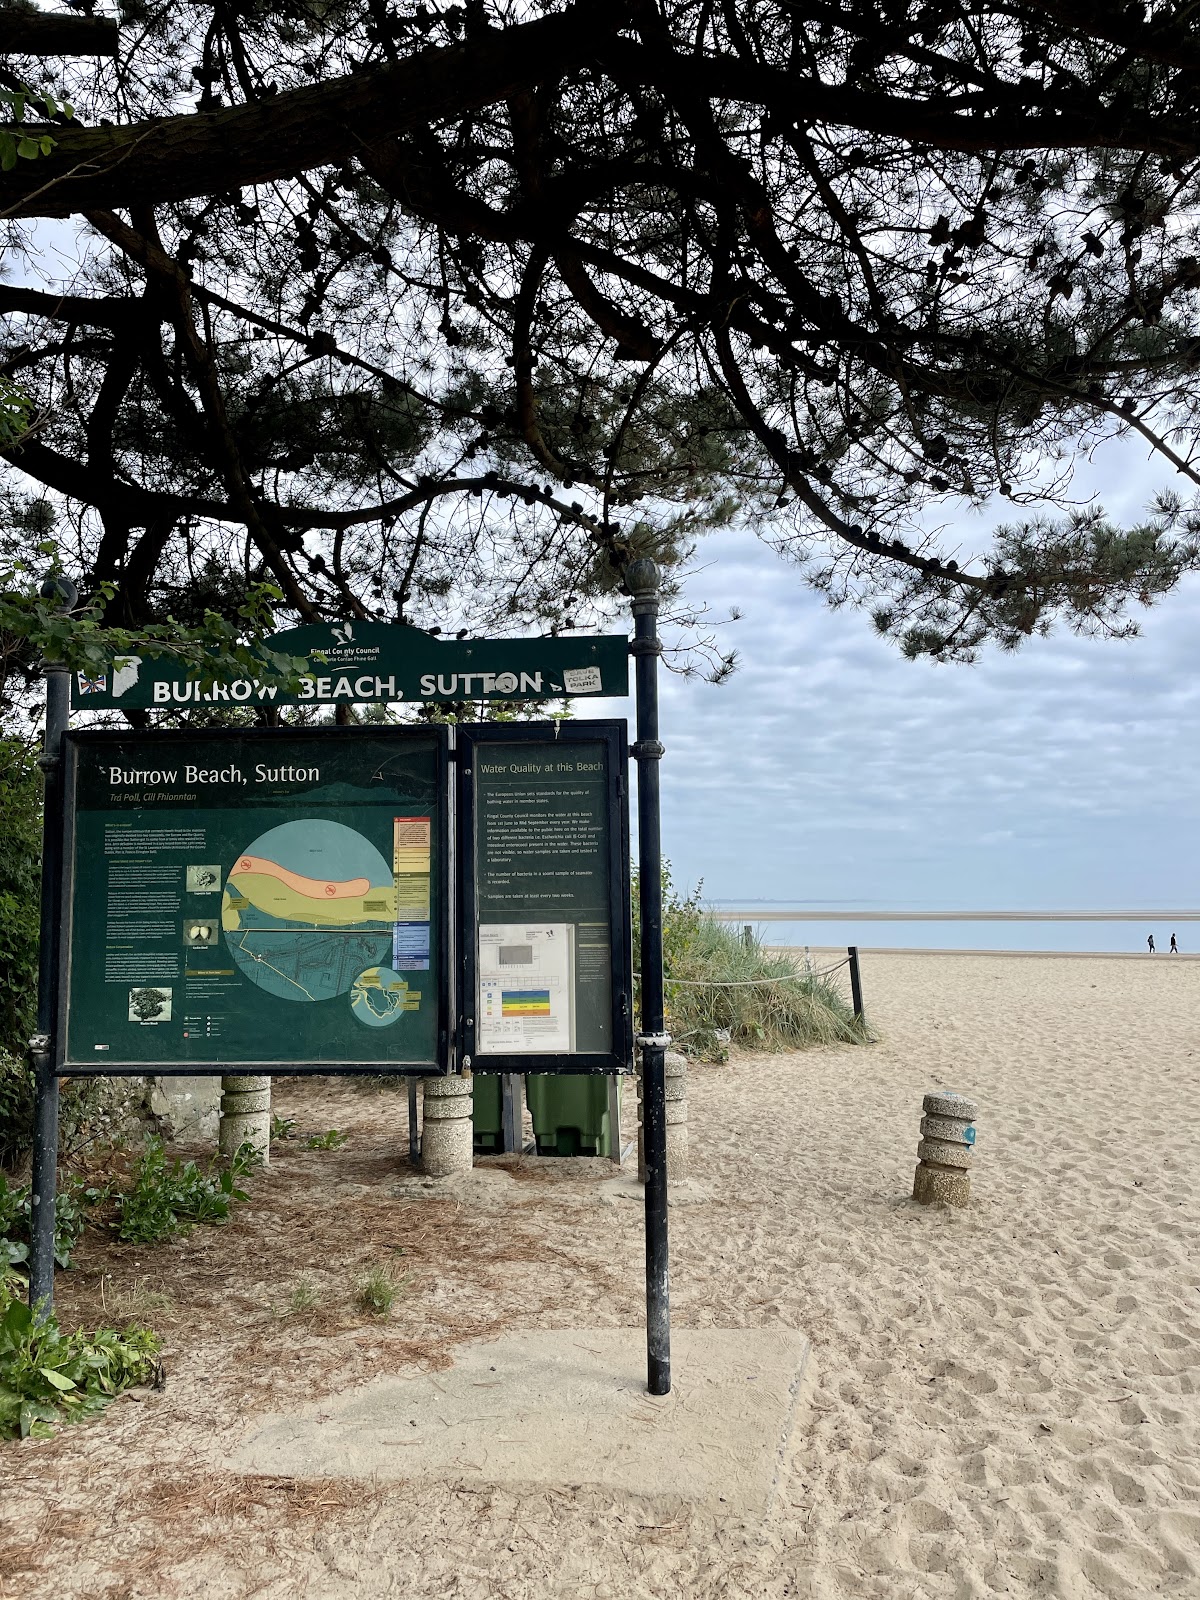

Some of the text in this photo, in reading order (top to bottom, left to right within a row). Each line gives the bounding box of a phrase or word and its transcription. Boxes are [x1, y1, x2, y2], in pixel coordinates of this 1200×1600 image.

[154, 672, 542, 702] BURROW BEACH, SUTTON
[110, 764, 320, 785] Burrow Beach, Sutton
[481, 762, 603, 774] Water Quality at this Beach
[110, 792, 197, 803] Trá Poll, Cill Fhionntan
